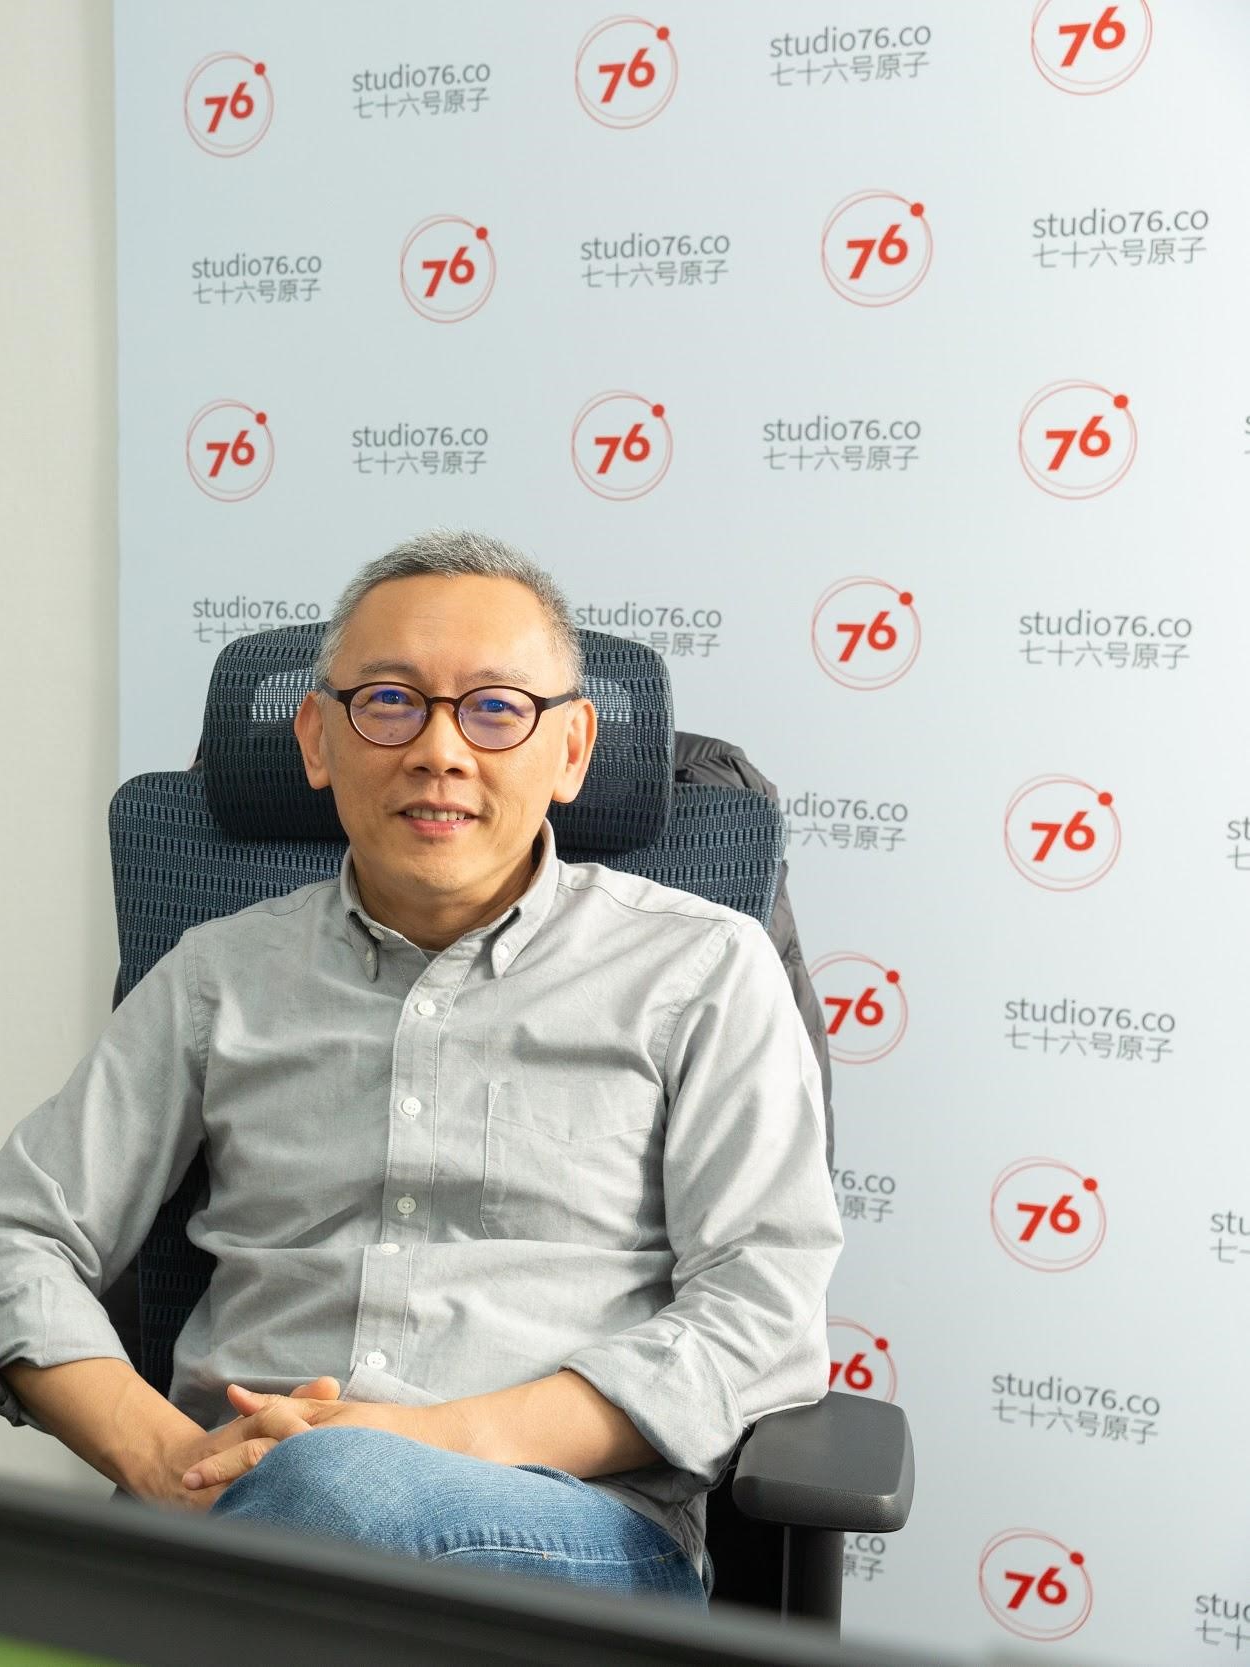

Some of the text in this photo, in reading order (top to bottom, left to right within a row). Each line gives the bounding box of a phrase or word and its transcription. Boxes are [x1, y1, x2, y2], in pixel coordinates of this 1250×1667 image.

[770, 25, 931, 58] studio76.co
[1059, 6, 1126, 67] 76
[352, 63, 491, 92] studio76.co
[599, 48, 655, 103] 76
[770, 52, 931, 87] 七十六号原子
[205, 83, 254, 133] 76
[353, 88, 490, 119] 七十六号原子
[1032, 207, 1209, 238] studio76.co
[580, 232, 731, 261] studio76.co
[847, 224, 909, 280] 76
[1032, 235, 1208, 268] 七十六号原子
[192, 252, 322, 279] studio76.co
[422, 247, 475, 298] 76
[580, 260, 729, 288] 七十六号原子
[193, 279, 321, 304] 七十六号原子
[352, 422, 488, 449] studio76.co
[763, 414, 921, 442] studio76.co
[1046, 415, 1112, 471] 76
[206, 431, 255, 477] 76
[352, 450, 487, 475] 七十六号原子
[595, 423, 651, 474] 76
[763, 445, 920, 471] 七十六号原子
[192, 594, 320, 620] studio76.co
[575, 601, 722, 628] studio76.co
[1019, 608, 1192, 639] studio76.co
[837, 610, 898, 663] 76
[1019, 640, 1191, 670] 七十六号原子
[782, 791, 908, 823] udio76.co
[786, 820, 906, 852] 十六号原子
[1030, 811, 1096, 862] 76
[824, 987, 884, 1035] 76
[1005, 998, 1176, 1033] studio76.co
[1006, 1028, 1175, 1063] 七十六号原子
[1016, 1194, 1081, 1242] 76
[992, 1372, 1161, 1416] studio76.co
[992, 1399, 1159, 1445] 七十六号原子
[1005, 1567, 1068, 1610] 76
